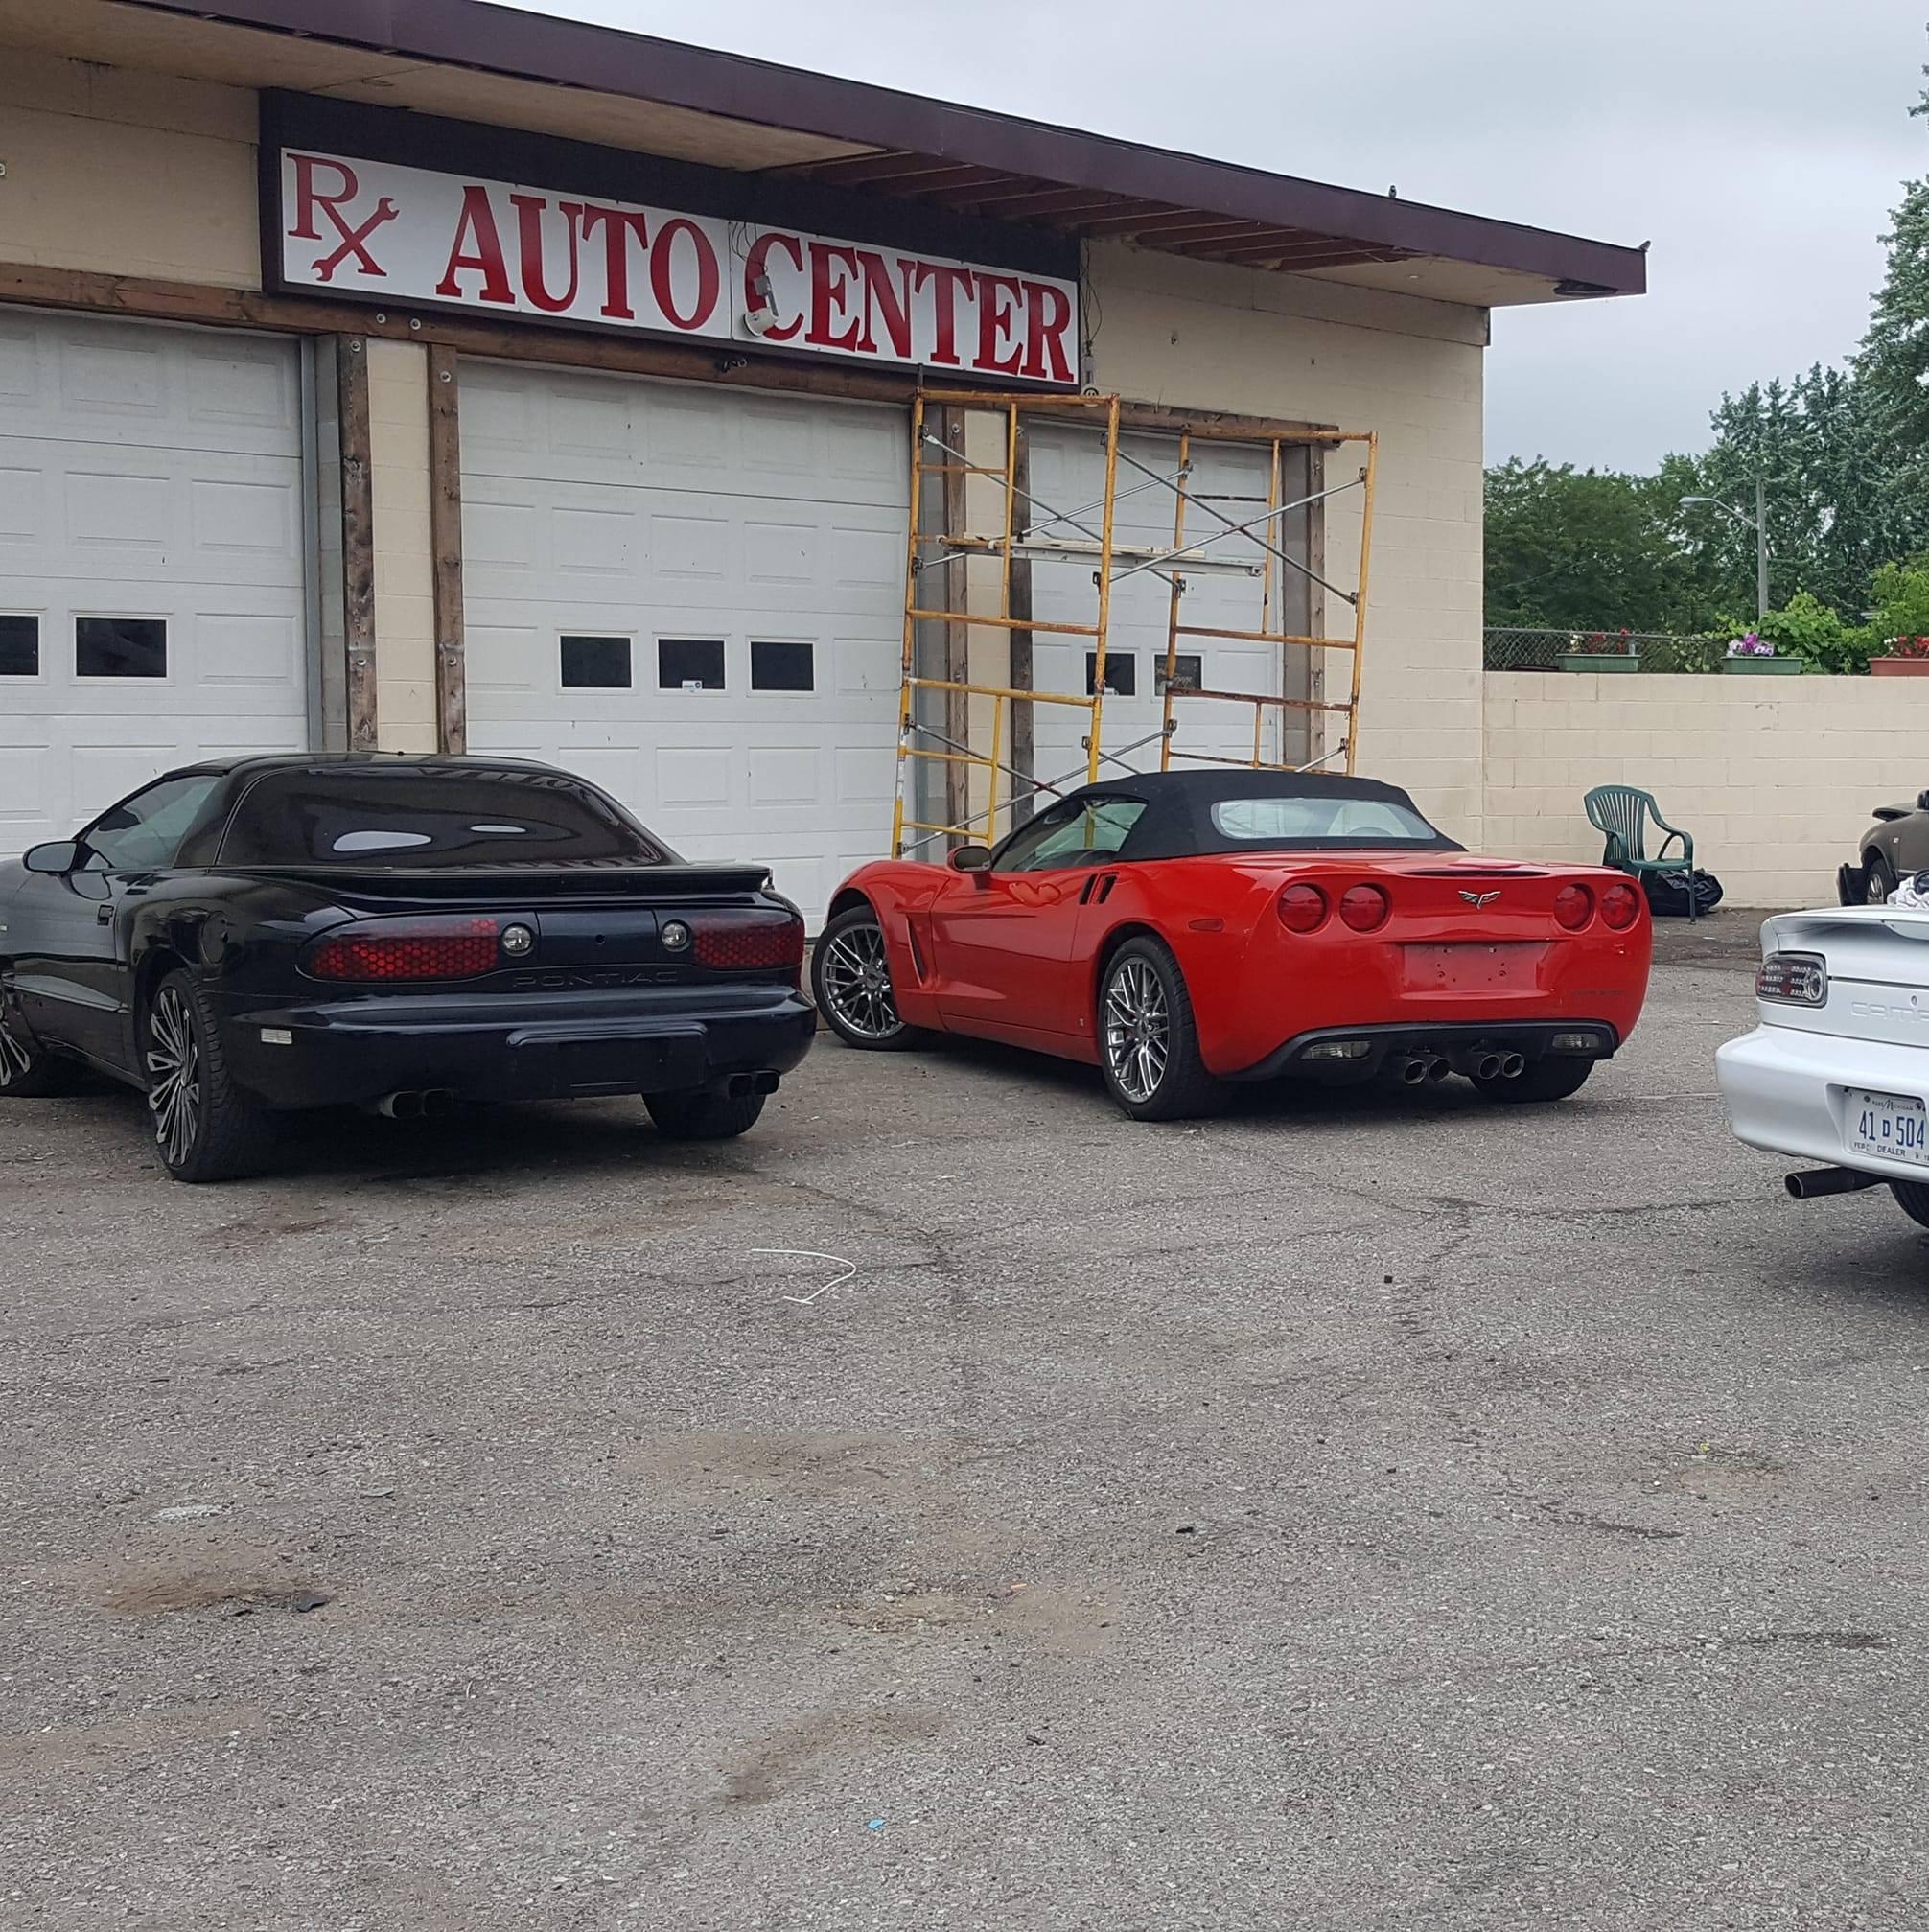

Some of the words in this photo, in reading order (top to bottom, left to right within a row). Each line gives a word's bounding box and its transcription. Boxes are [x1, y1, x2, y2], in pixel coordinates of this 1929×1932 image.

[435, 185, 720, 331] AUTO
[744, 232, 1075, 383] CENTER
[512, 970, 678, 989] PONTIAC
[1877, 1145, 1906, 1157] DEALER
